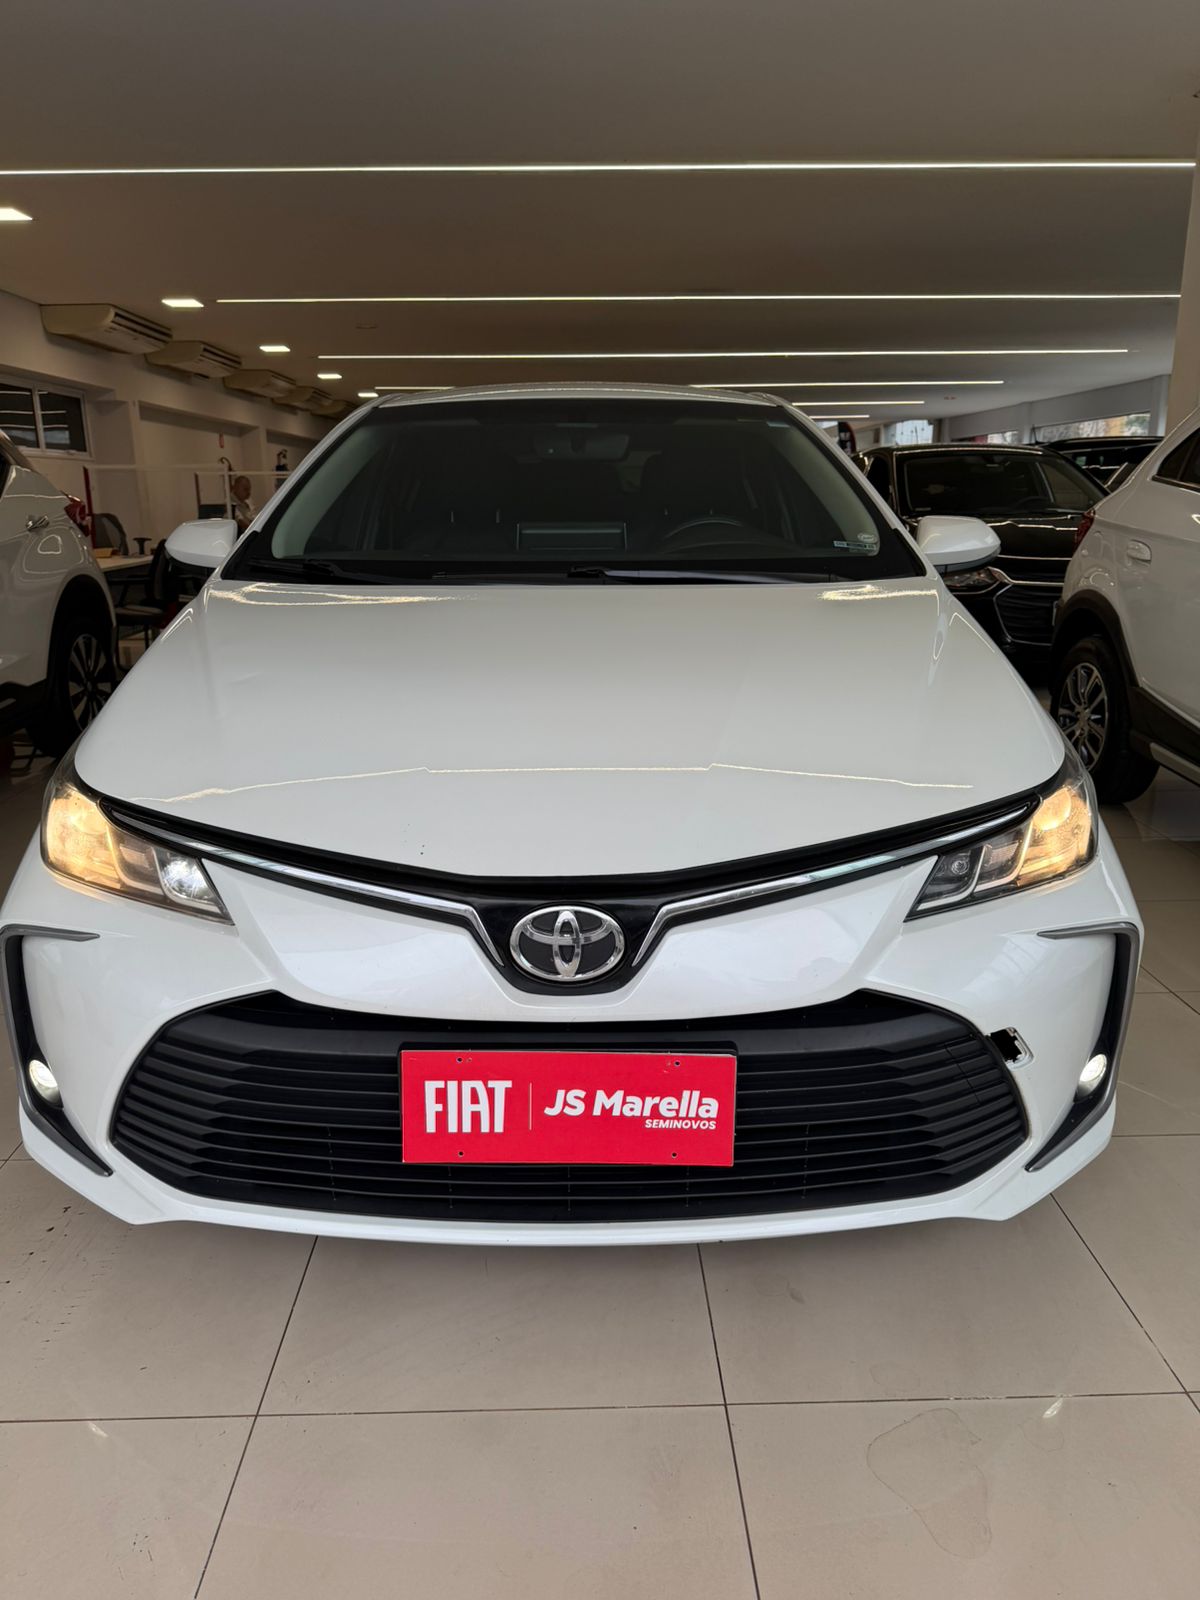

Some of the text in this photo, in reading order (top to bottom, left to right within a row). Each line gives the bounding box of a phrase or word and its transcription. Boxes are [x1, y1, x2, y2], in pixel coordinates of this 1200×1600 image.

[424, 1080, 513, 1134] FIAT
[543, 1088, 719, 1119] JS Marella
[644, 1118, 717, 1130] SEMINOVOS
